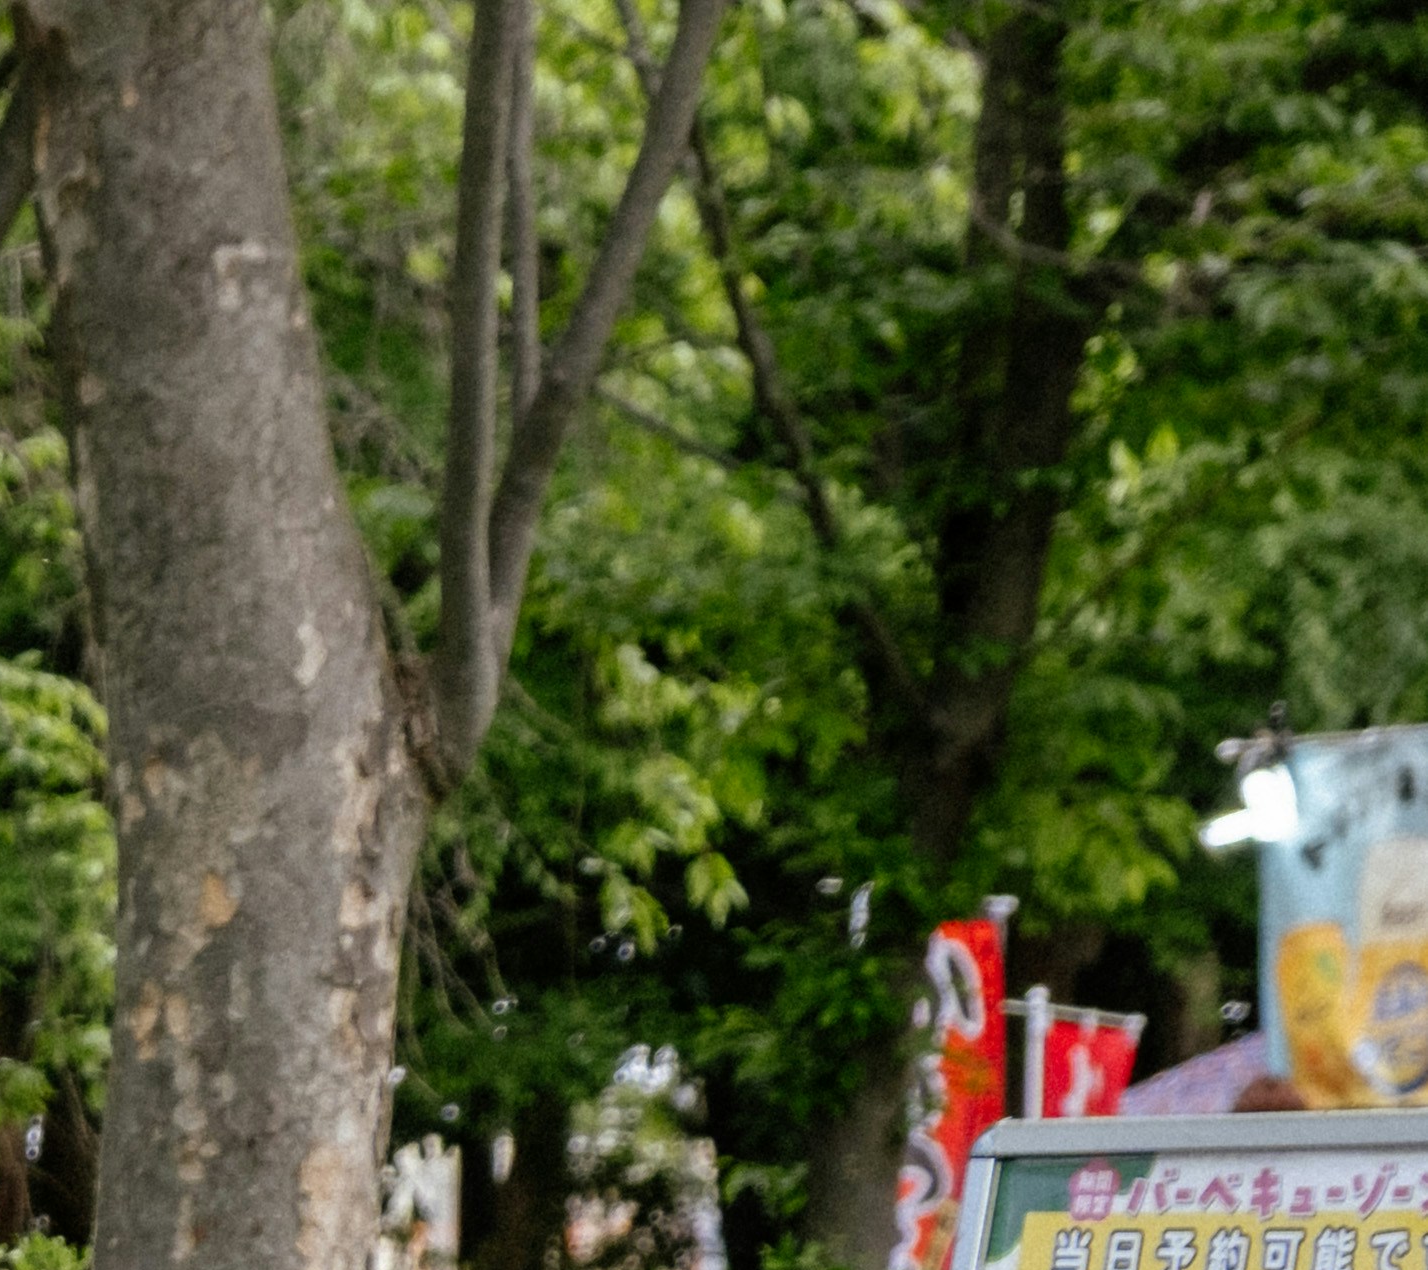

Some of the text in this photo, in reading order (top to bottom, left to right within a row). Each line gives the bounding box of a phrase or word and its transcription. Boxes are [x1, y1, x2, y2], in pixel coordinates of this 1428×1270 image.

[1125, 1162, 1428, 1219] バーベキューゾー
